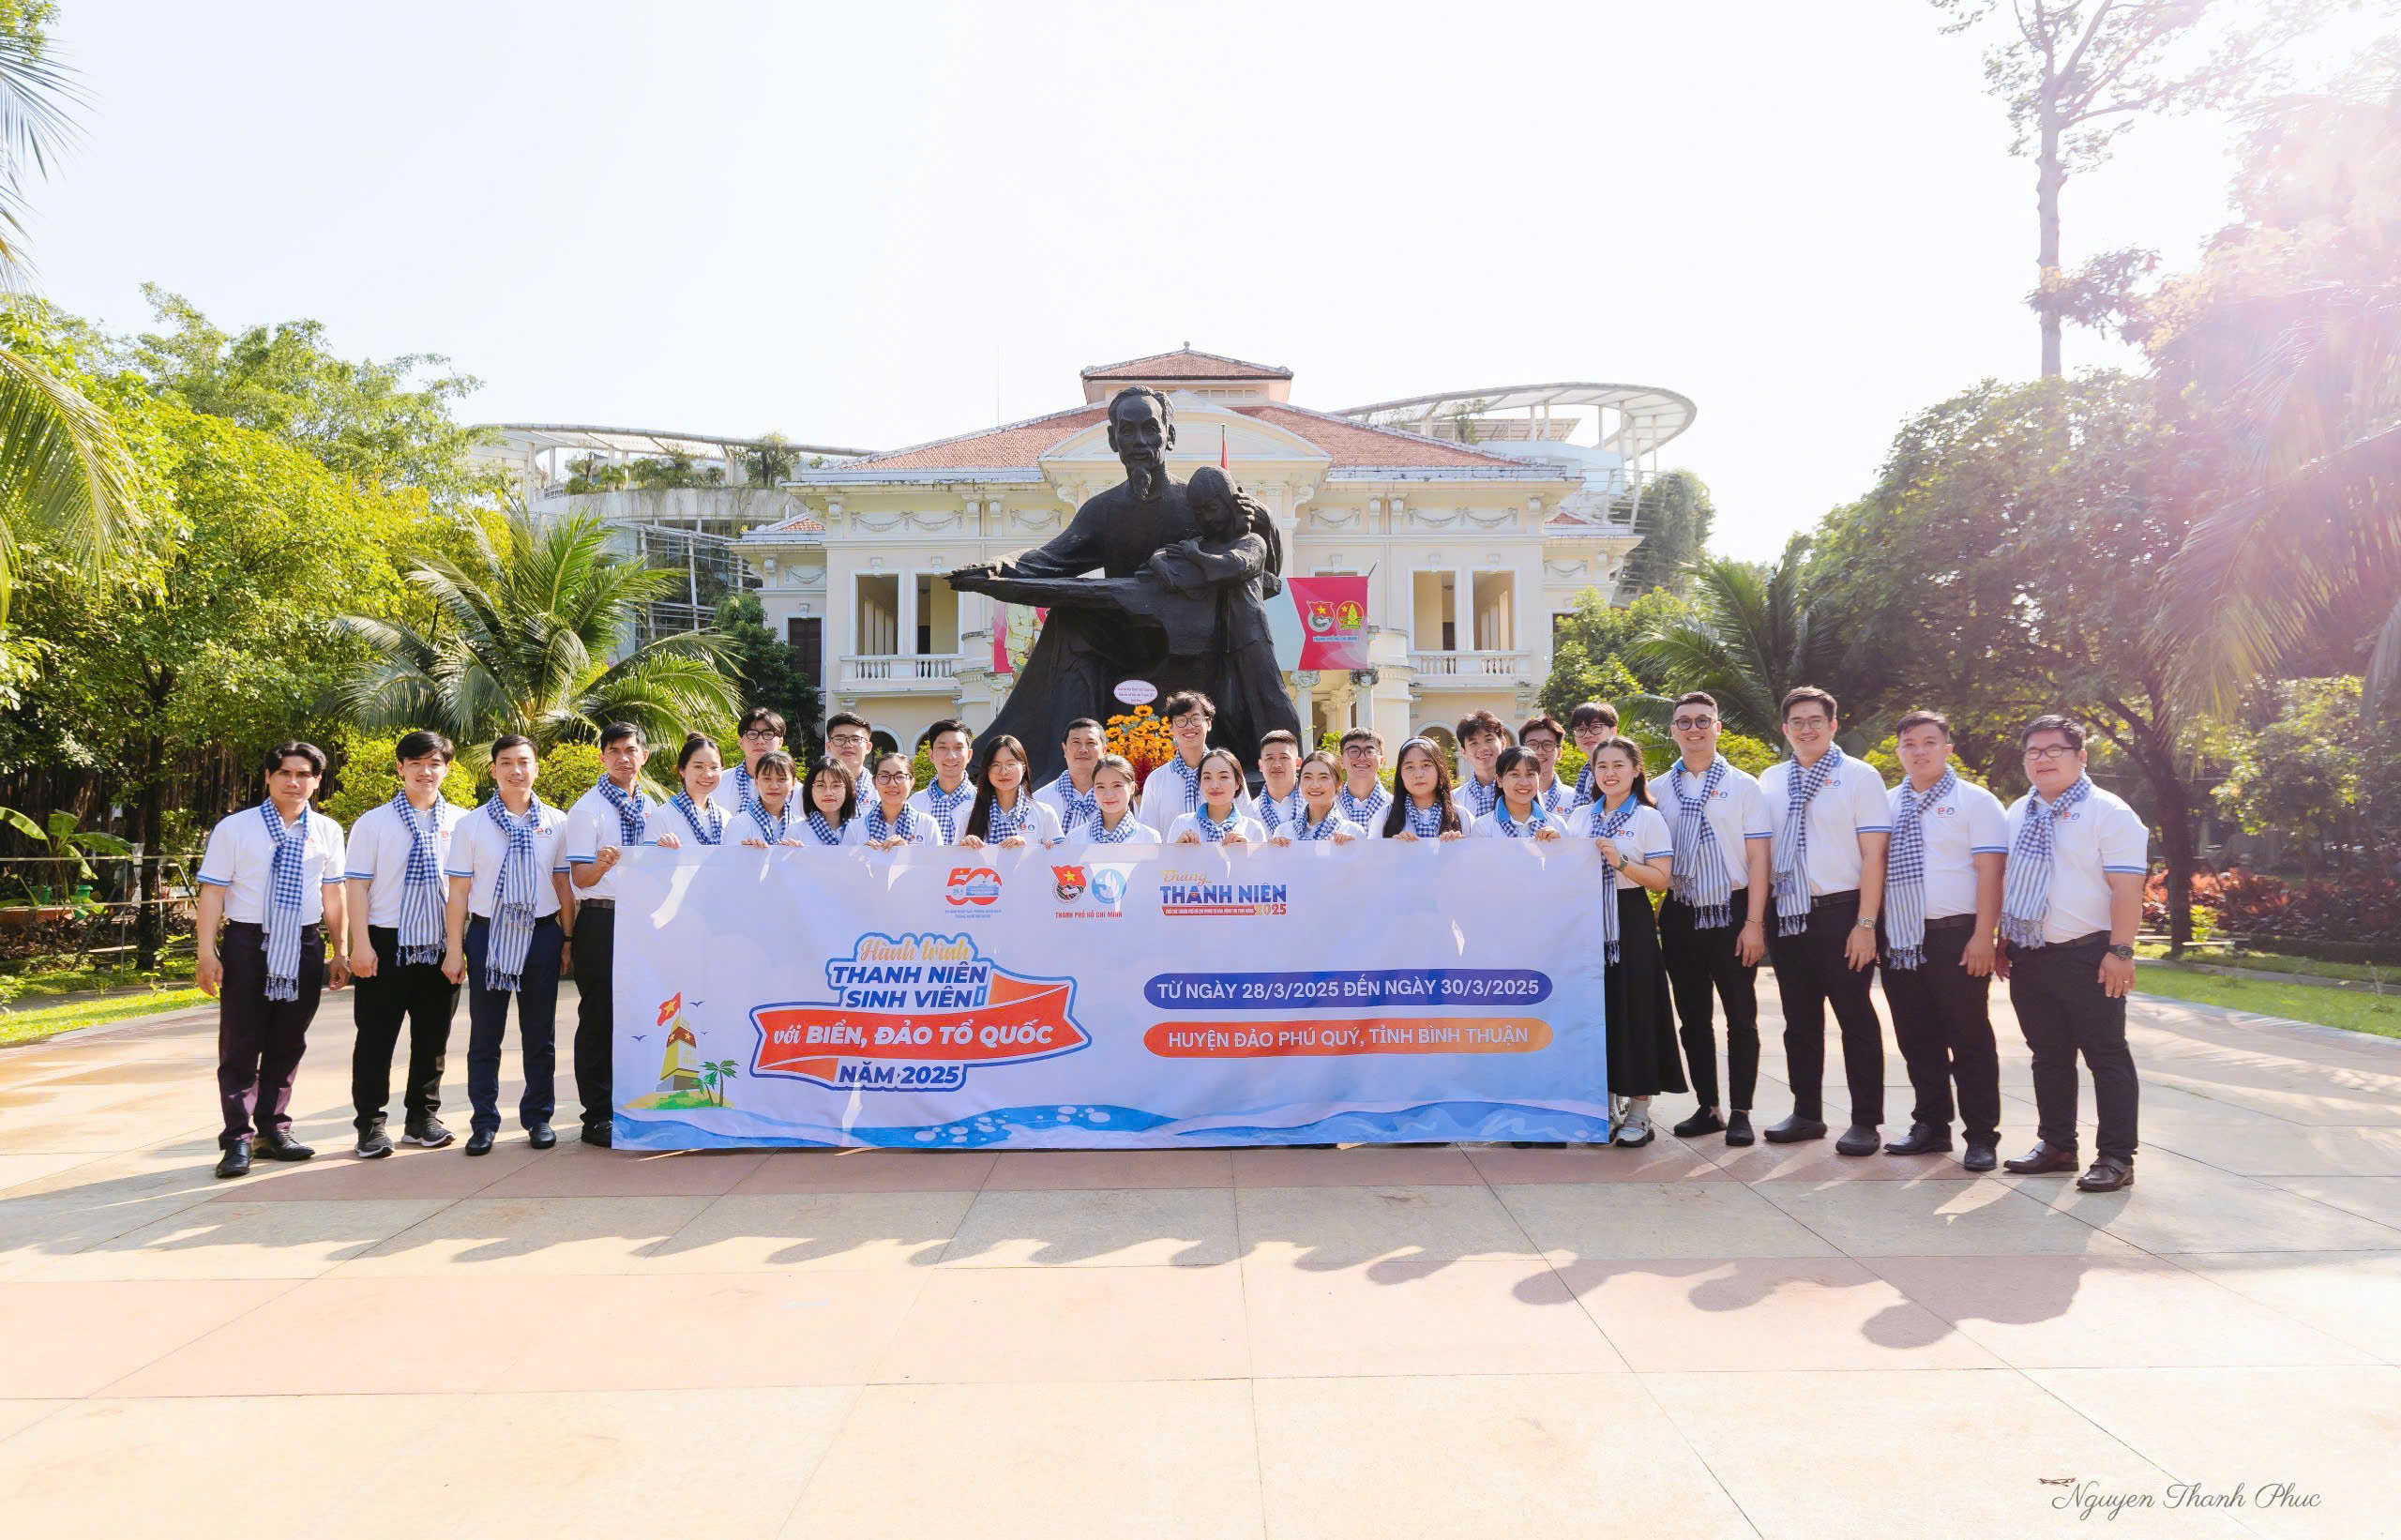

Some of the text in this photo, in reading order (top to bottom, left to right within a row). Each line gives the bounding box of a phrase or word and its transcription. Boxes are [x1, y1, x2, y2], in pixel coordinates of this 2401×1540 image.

[1160, 882, 1287, 903] THANH NIÊN
[1254, 903, 1287, 915] 2025
[860, 939, 970, 961] Hành trình
[833, 960, 988, 984] THANH NIÊN
[845, 985, 974, 1008] SINH VIÊN
[1156, 974, 1539, 1001] TỪ NGÀY 28/3/2025 ĐẾN NGÀY 30/3/2025
[774, 1019, 1054, 1049] với BIỂN, ĐẢO TỔ QUỐC
[1169, 1024, 1529, 1051] HUYỆN ĐẢO PHÚ QUÝ, TỈNH BÌNH THUẬN
[838, 1061, 960, 1085] NĂM 2025
